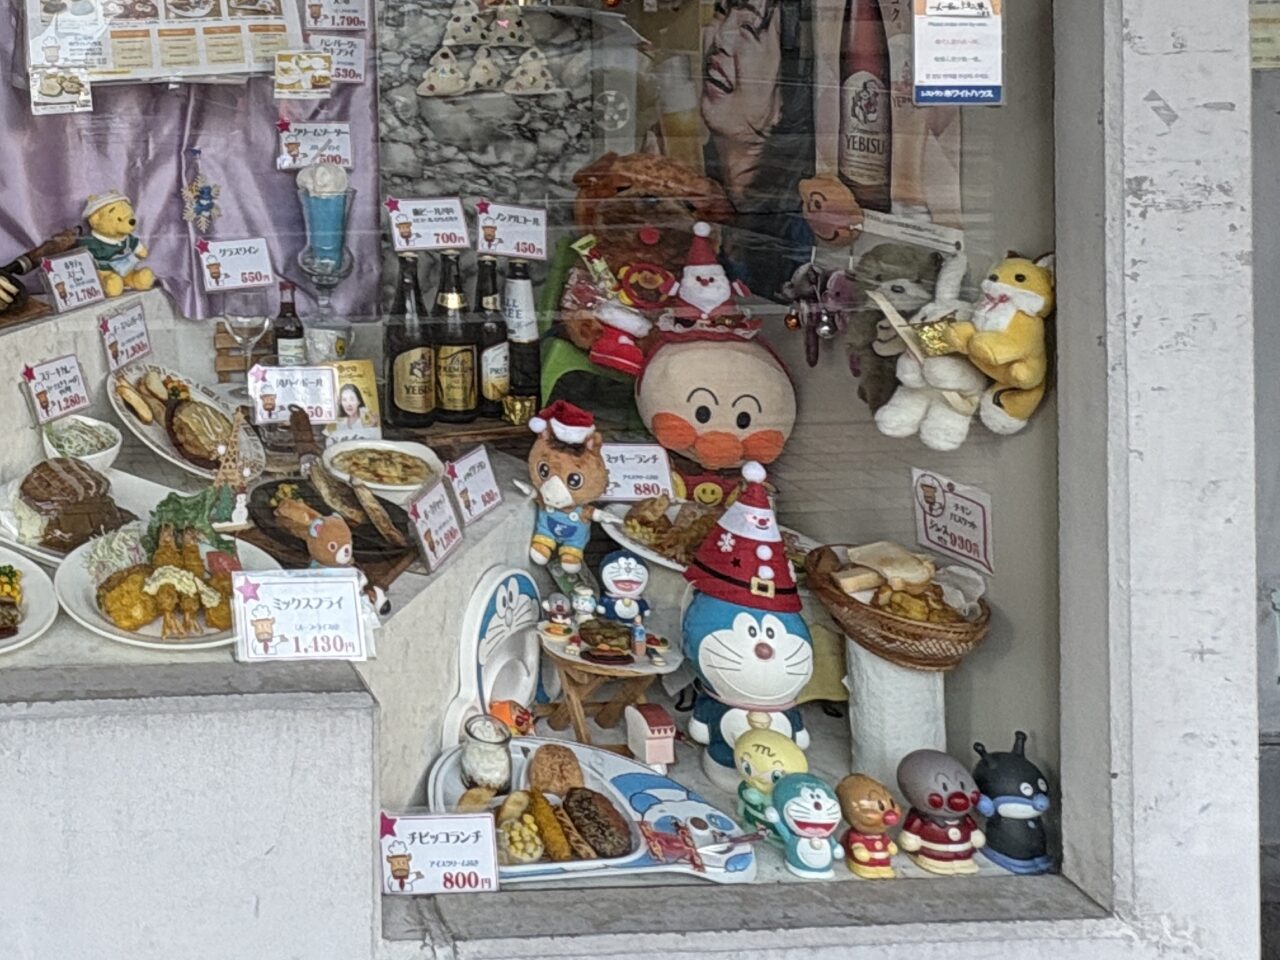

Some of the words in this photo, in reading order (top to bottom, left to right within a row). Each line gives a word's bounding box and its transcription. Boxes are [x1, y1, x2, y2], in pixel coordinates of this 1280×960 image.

[331, 67, 362, 80] ,530円
[944, 89, 994, 98] ホワイトハウス
[845, 134, 885, 155] YEBISU
[495, 212, 541, 226] ノンアルコール
[434, 232, 465, 244] 700円
[514, 241, 543, 255] 450円
[241, 271, 270, 283] 550円
[633, 483, 669, 496] 880円
[949, 532, 980, 558] 930円
[272, 596, 344, 610] ミックスフライ
[293, 634, 356, 653] 1,430円
[407, 830, 482, 845] チビッコランチ
[443, 871, 491, 889] 800円
